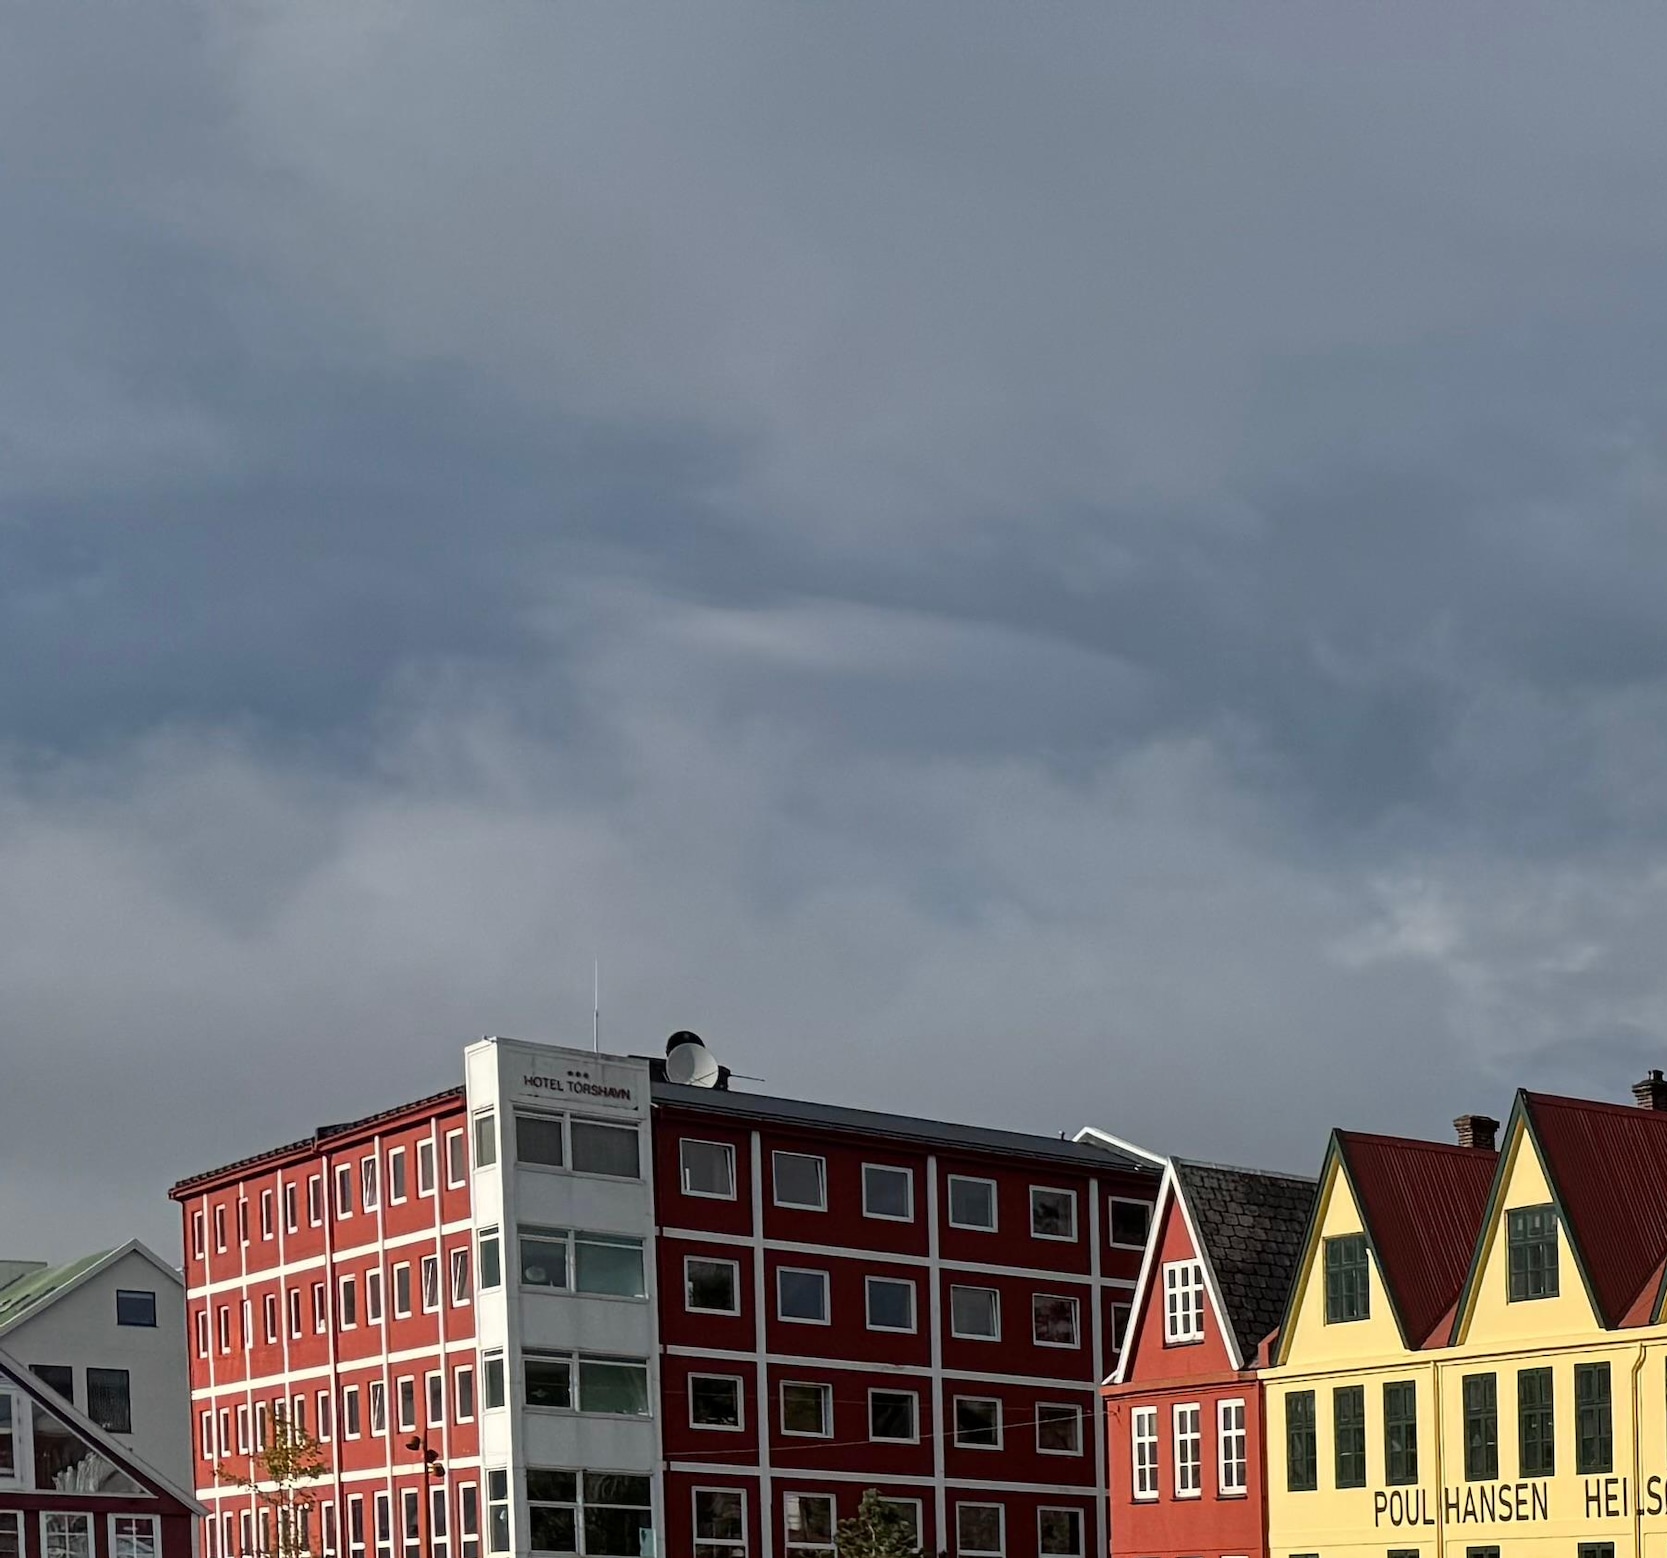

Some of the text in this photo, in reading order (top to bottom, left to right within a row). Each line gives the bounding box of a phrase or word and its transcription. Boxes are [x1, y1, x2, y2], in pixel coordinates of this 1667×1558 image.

[523, 1075, 564, 1092] HOTEL
[1374, 1488, 1435, 1528] POUL
[1444, 1481, 1548, 1524] HANSEN
